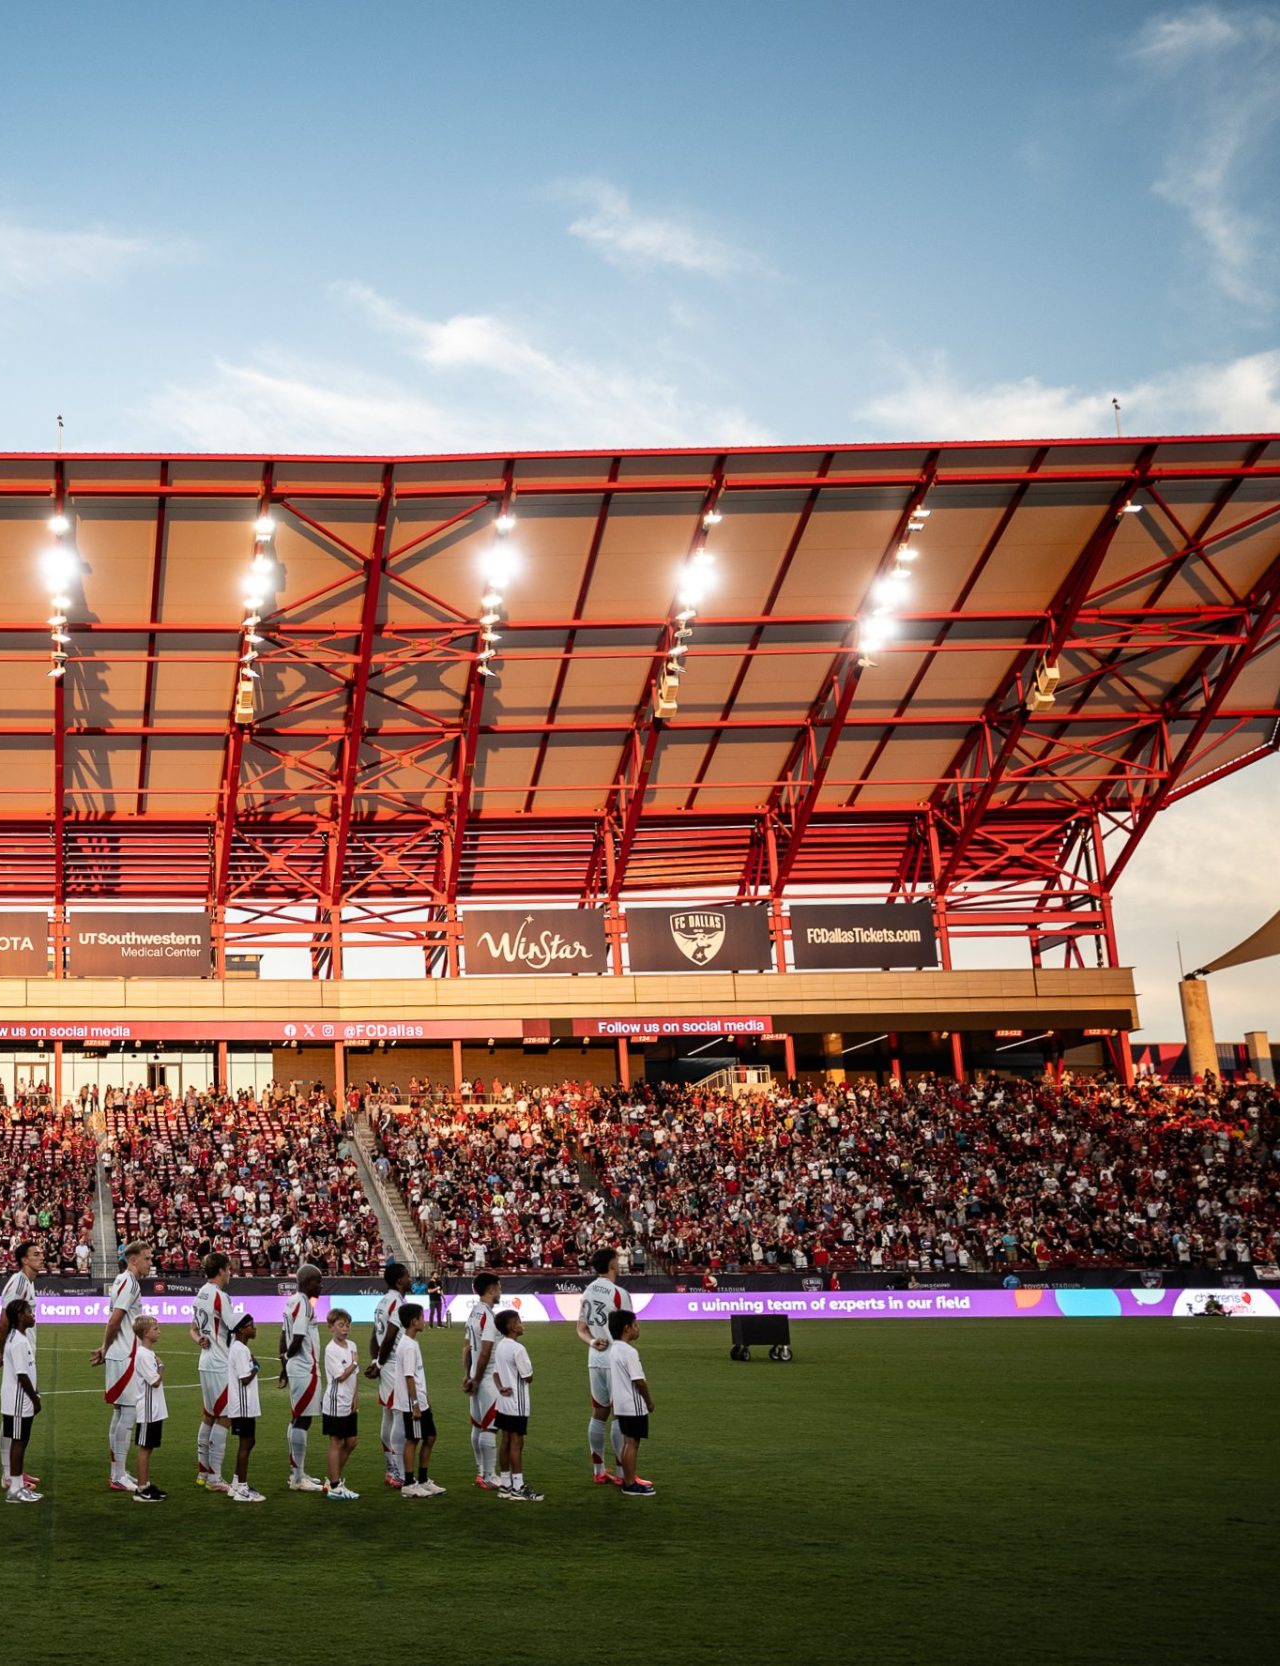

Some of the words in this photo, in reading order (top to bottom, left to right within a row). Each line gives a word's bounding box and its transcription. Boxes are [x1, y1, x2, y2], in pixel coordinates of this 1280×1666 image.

[675, 915, 687, 929] FC
[689, 915, 721, 929] DALLAS
[806, 927, 921, 943] FCDallasTickets.com
[477, 918, 593, 969] WinStar
[121, 947, 163, 958] Medical
[165, 947, 201, 958] Center
[11, 1027, 27, 1037] us
[30, 1027, 46, 1037] on
[49, 1025, 88, 1037] social
[91, 1025, 131, 1037] media
[343, 1024, 424, 1038] @FCDallas
[598, 1021, 640, 1034] Follow
[643, 1023, 660, 1033] us
[663, 1022, 680, 1033] on
[682, 1020, 722, 1032] social
[724, 1019, 765, 1032] media
[167, 1284, 193, 1292] TOYOTA
[41, 1303, 81, 1315] team
[84, 1302, 101, 1315] of
[162, 1302, 177, 1315] in
[688, 1302, 698, 1312] a
[702, 1298, 764, 1313] winning
[767, 1299, 807, 1311] team
[810, 1297, 826, 1311] of
[828, 1297, 886, 1313] experts
[888, 1296, 904, 1310] in
[909, 1298, 933, 1310] our
[936, 1295, 971, 1309] field
[584, 1299, 608, 1327] 23
